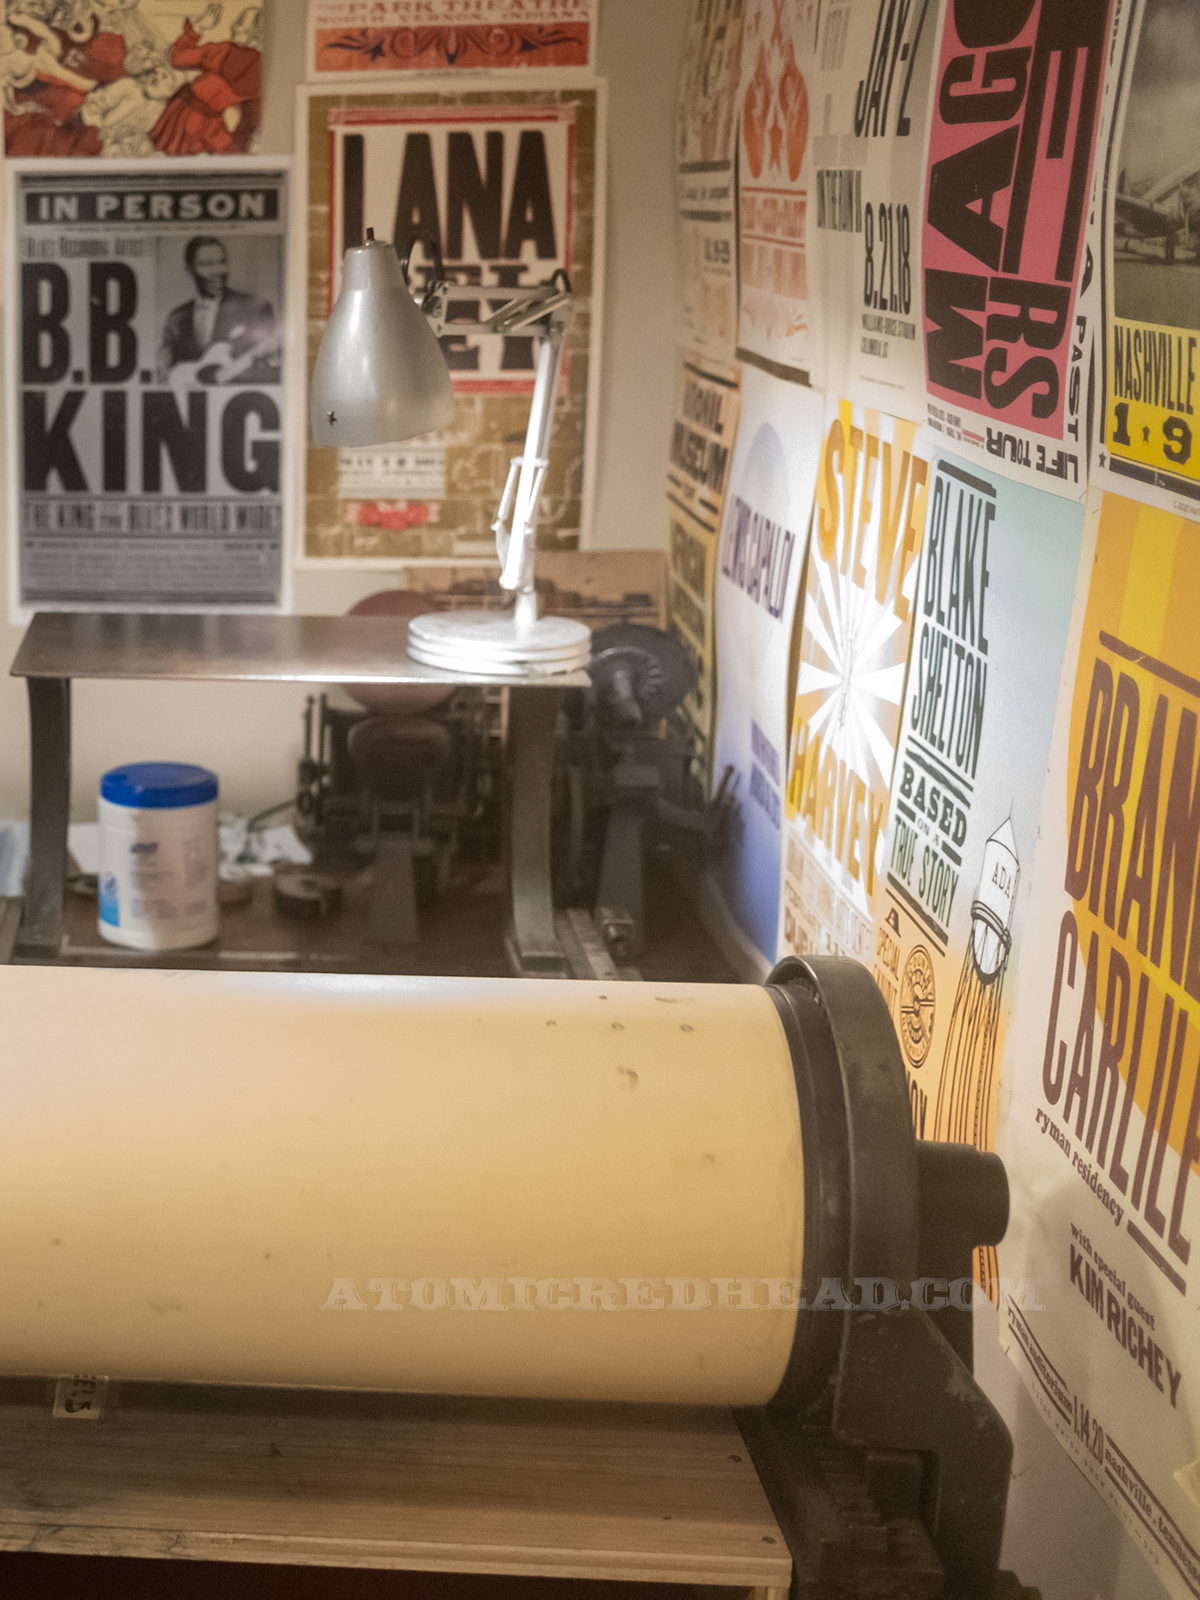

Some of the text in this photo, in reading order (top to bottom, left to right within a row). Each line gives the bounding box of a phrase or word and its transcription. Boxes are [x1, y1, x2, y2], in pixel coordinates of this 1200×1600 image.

[38, 192, 266, 221] IN PERSON
[342, 130, 558, 260] LANA
[22, 261, 152, 383] B.B.
[1114, 324, 1197, 416] NASHVILLE
[22, 389, 281, 493] KING
[986, 426, 1032, 468] TOUR
[817, 418, 930, 622] STEVE
[923, 475, 996, 656] BLAKE
[910, 621, 988, 780] SHELTON
[785, 717, 884, 898] HARVEY
[899, 760, 967, 848] BASED
[918, 817, 931, 837] ON
[1064, 656, 1200, 1003] BRAN
[885, 906, 902, 938] A
[890, 813, 918, 888] TRUE
[918, 844, 960, 929] STORY
[991, 861, 1012, 899] ADA
[1042, 909, 1200, 1267] CARLILE
[1035, 1107, 1125, 1227] ryman residency
[1070, 1222, 1156, 1332] with special guest
[1070, 1243, 1182, 1410] KIM RICHEY
